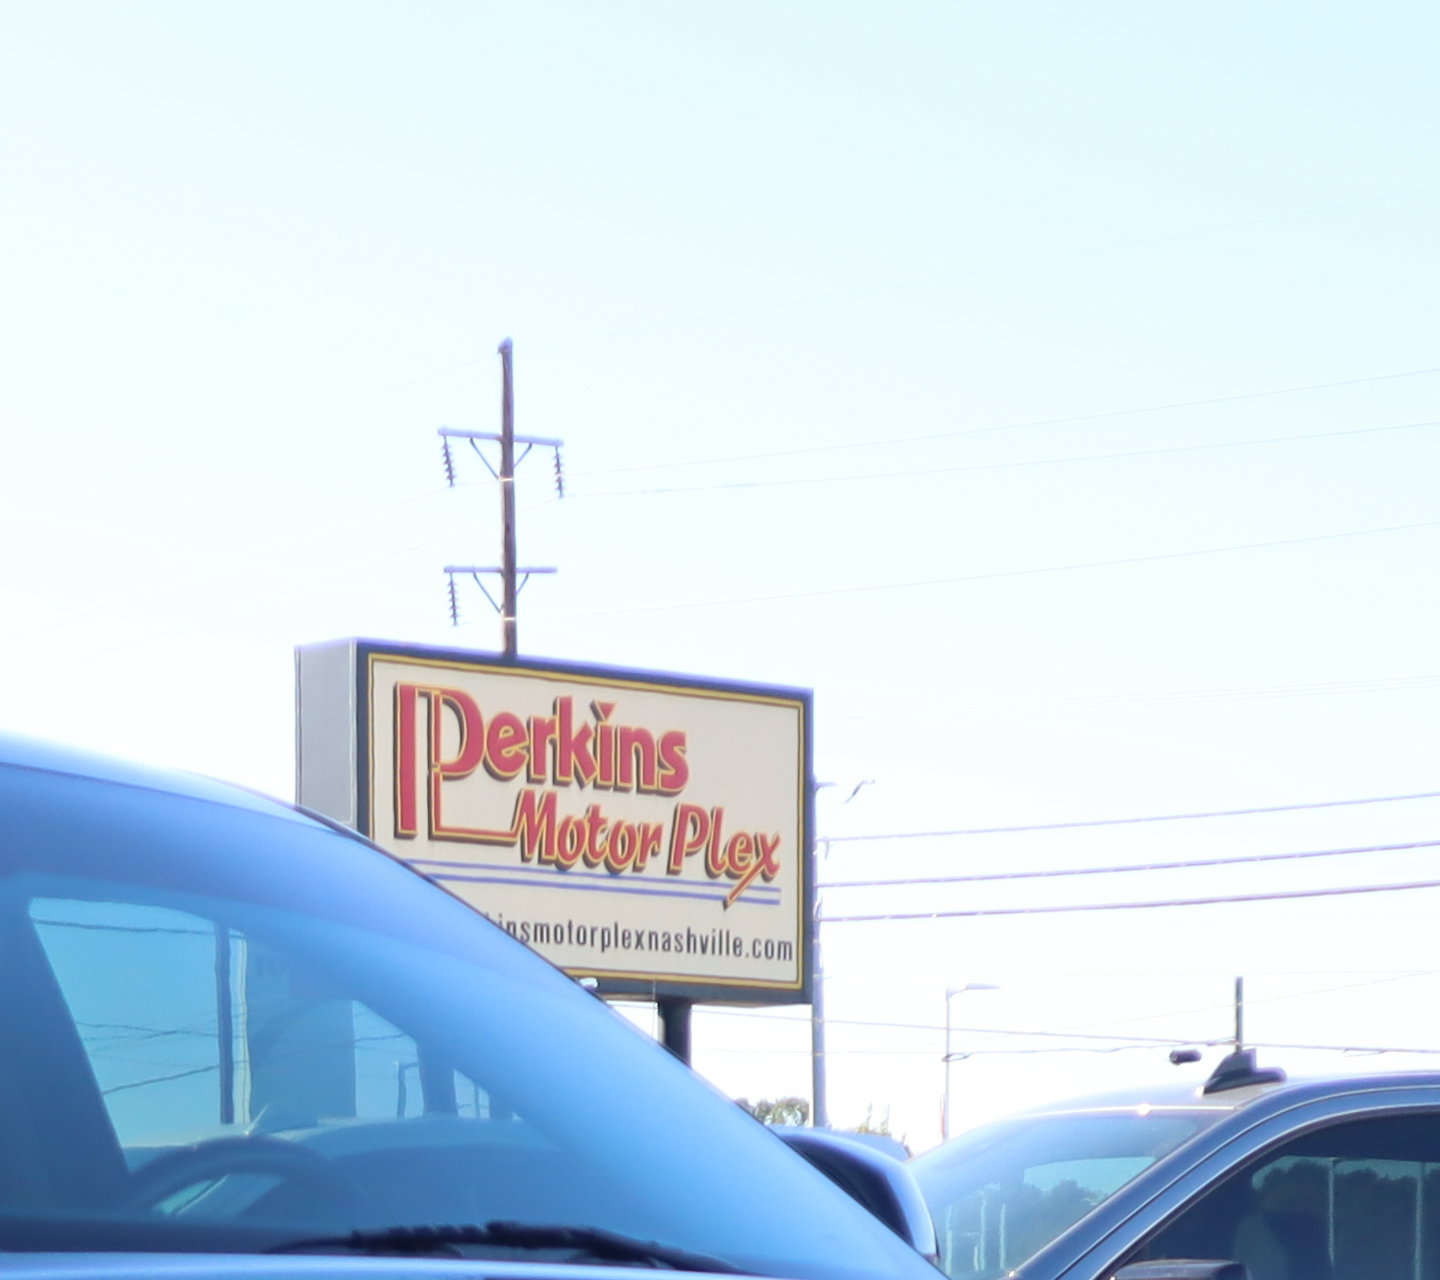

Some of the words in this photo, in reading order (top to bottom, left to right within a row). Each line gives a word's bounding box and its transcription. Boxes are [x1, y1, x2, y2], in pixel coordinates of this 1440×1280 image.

[394, 681, 689, 838] Perkins
[514, 789, 662, 873] Motor
[667, 803, 781, 907] Plex
[485, 912, 795, 961] insmotorplexnashville.com
